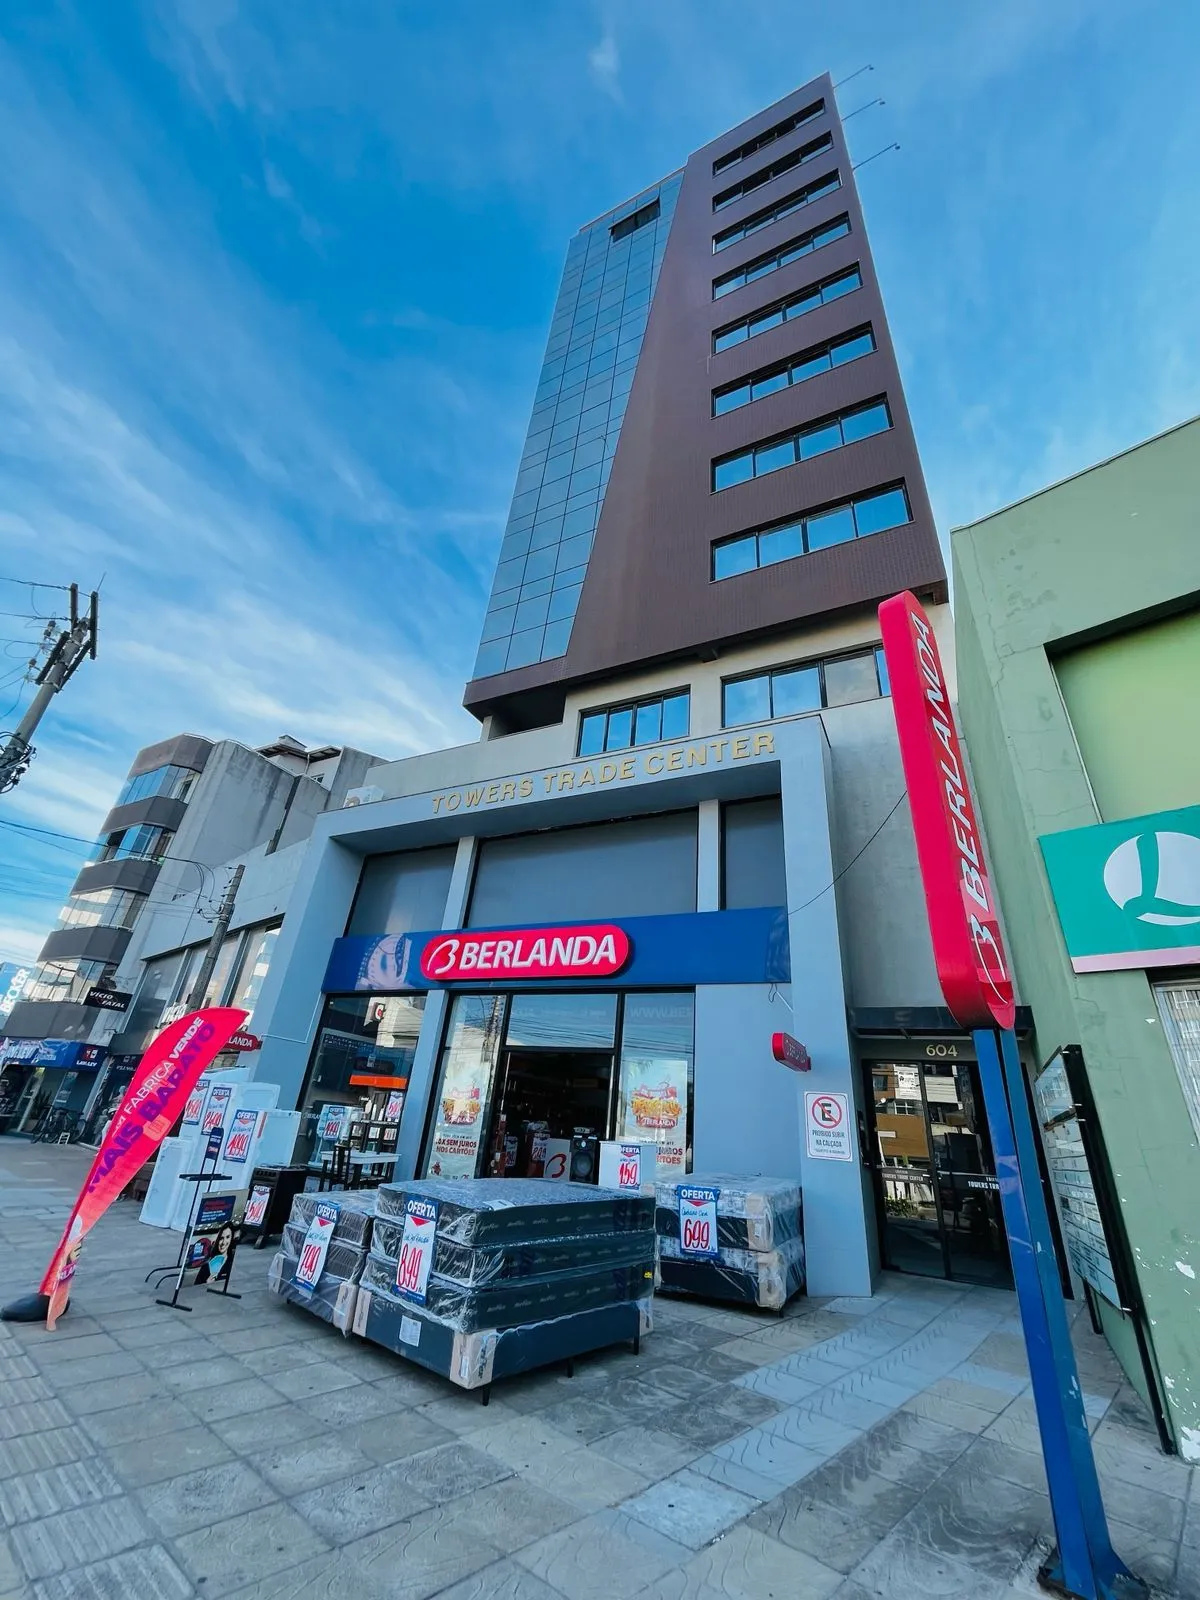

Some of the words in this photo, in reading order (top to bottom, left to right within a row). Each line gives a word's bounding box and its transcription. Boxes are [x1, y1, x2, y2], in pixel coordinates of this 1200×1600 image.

[910, 610, 990, 913] BERLANDA
[432, 776, 534, 814] TOWERS
[543, 752, 636, 795] TRADE
[643, 732, 776, 776] CENTER
[459, 934, 617, 970] BERLANDA
[101, 1000, 125, 1009] FATAL
[168, 1016, 204, 1060] VENDE
[228, 1035, 253, 1048] LANDA
[926, 1044, 958, 1058] 604
[138, 1023, 216, 1123] BARATO
[213, 1089, 231, 1097] OFERTA
[236, 1111, 257, 1119] OFERTA
[436, 1145, 448, 1153] NOS
[449, 1147, 475, 1156] CARTÕES
[446, 1139, 458, 1147] SEM
[459, 1140, 477, 1149] JUROS
[254, 1185, 271, 1193] OFERTA
[967, 1181, 989, 1189] TOWERS
[989, 1182, 1000, 1190] TRA
[681, 1189, 716, 1200] OFERTA
[317, 1205, 337, 1221] OFERTA
[407, 1201, 437, 1219] OFERTA
[684, 1218, 710, 1249] 699
[301, 1244, 322, 1281] 799
[398, 1244, 422, 1290] 899
